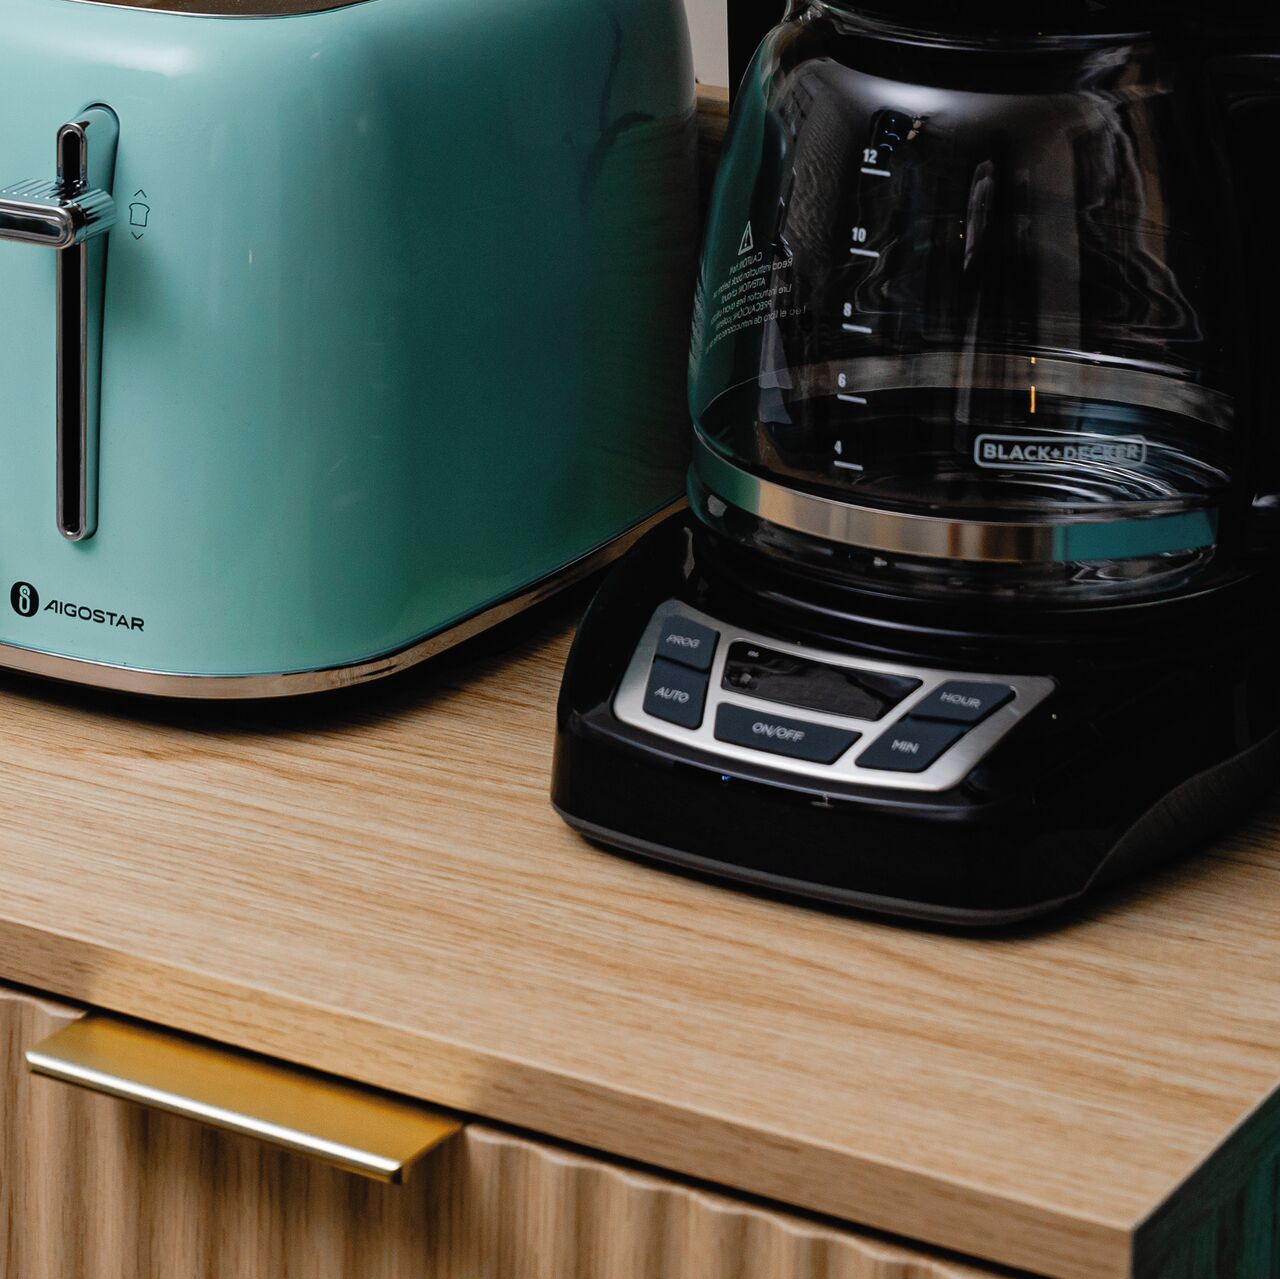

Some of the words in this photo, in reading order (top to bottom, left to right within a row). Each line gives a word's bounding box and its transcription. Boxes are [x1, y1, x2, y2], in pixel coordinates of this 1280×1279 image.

[863, 149, 877, 164] 12
[852, 227, 866, 242] 10
[843, 302, 852, 317] 8
[837, 373, 846, 388] 6
[834, 440, 842, 454] 4
[983, 442, 1139, 462] BLACK+DECKER
[43, 600, 145, 632] AIGOSTAR
[666, 634, 700, 648] PROG
[654, 686, 690, 704] AUTO
[940, 691, 982, 709] HOUR
[752, 722, 805, 743] ON/OFF
[891, 739, 920, 754] MIN
